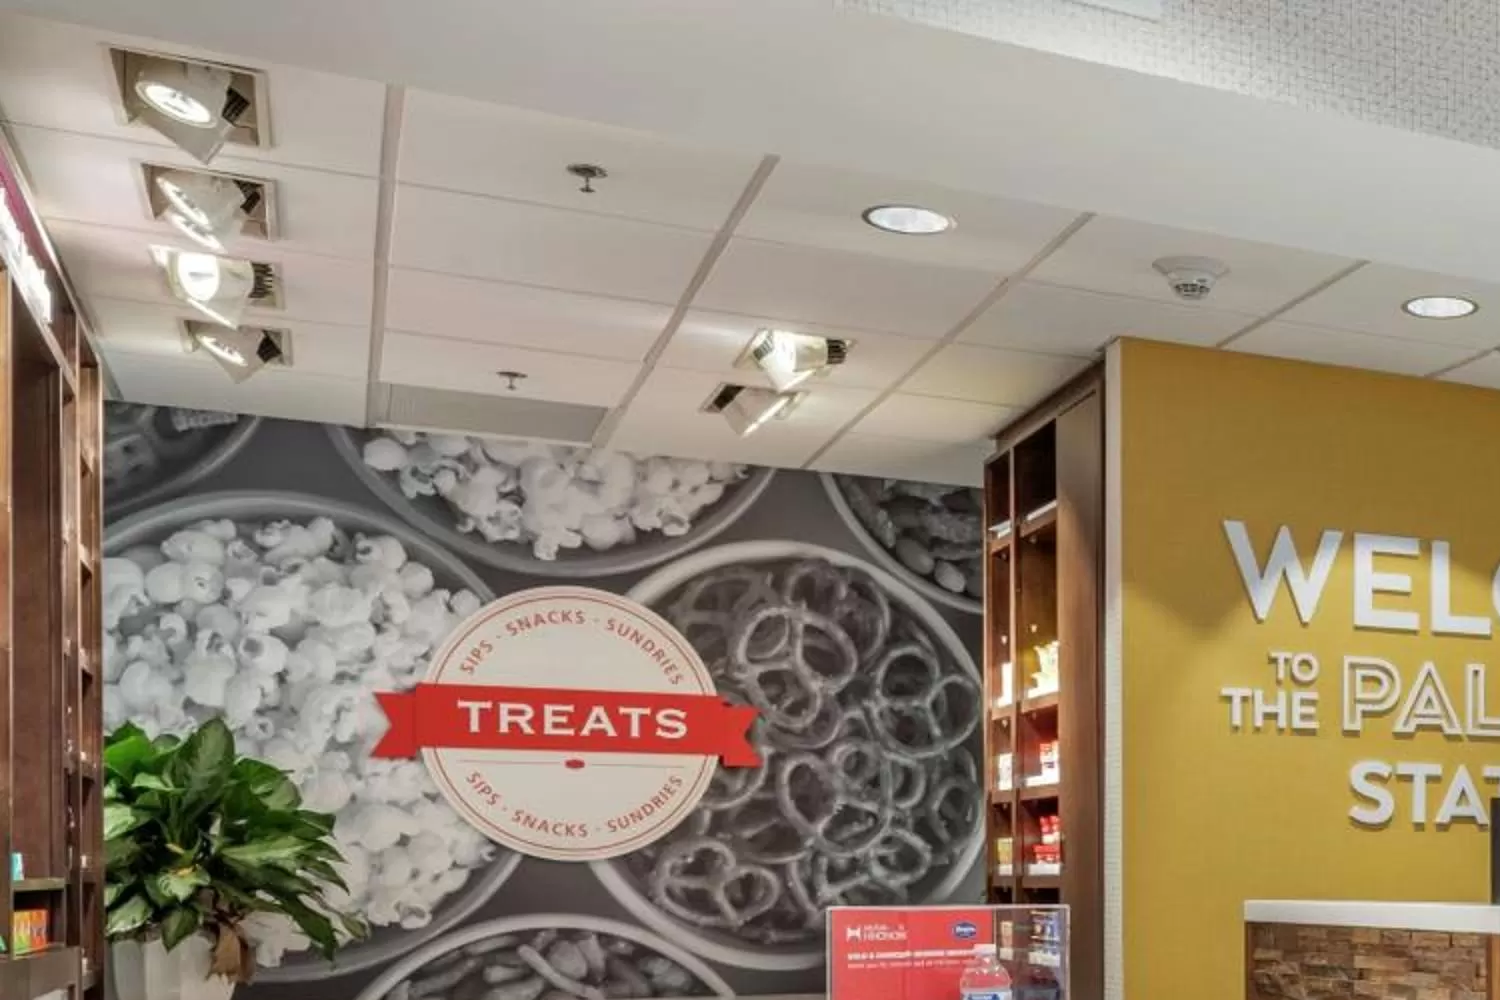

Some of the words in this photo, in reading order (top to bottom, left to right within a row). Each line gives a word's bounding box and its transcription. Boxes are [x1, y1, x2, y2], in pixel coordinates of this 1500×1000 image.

[459, 639, 494, 675] SIPS
[505, 609, 586, 637] SNACKS
[606, 618, 685, 686] SUNDRIES
[1269, 652, 1319, 684] TO
[457, 699, 689, 740] TREATS
[1221, 688, 1319, 730] THE
[466, 771, 500, 807] SIPS
[511, 808, 589, 838] SNACKS
[607, 774, 685, 834] SUNDRIES
